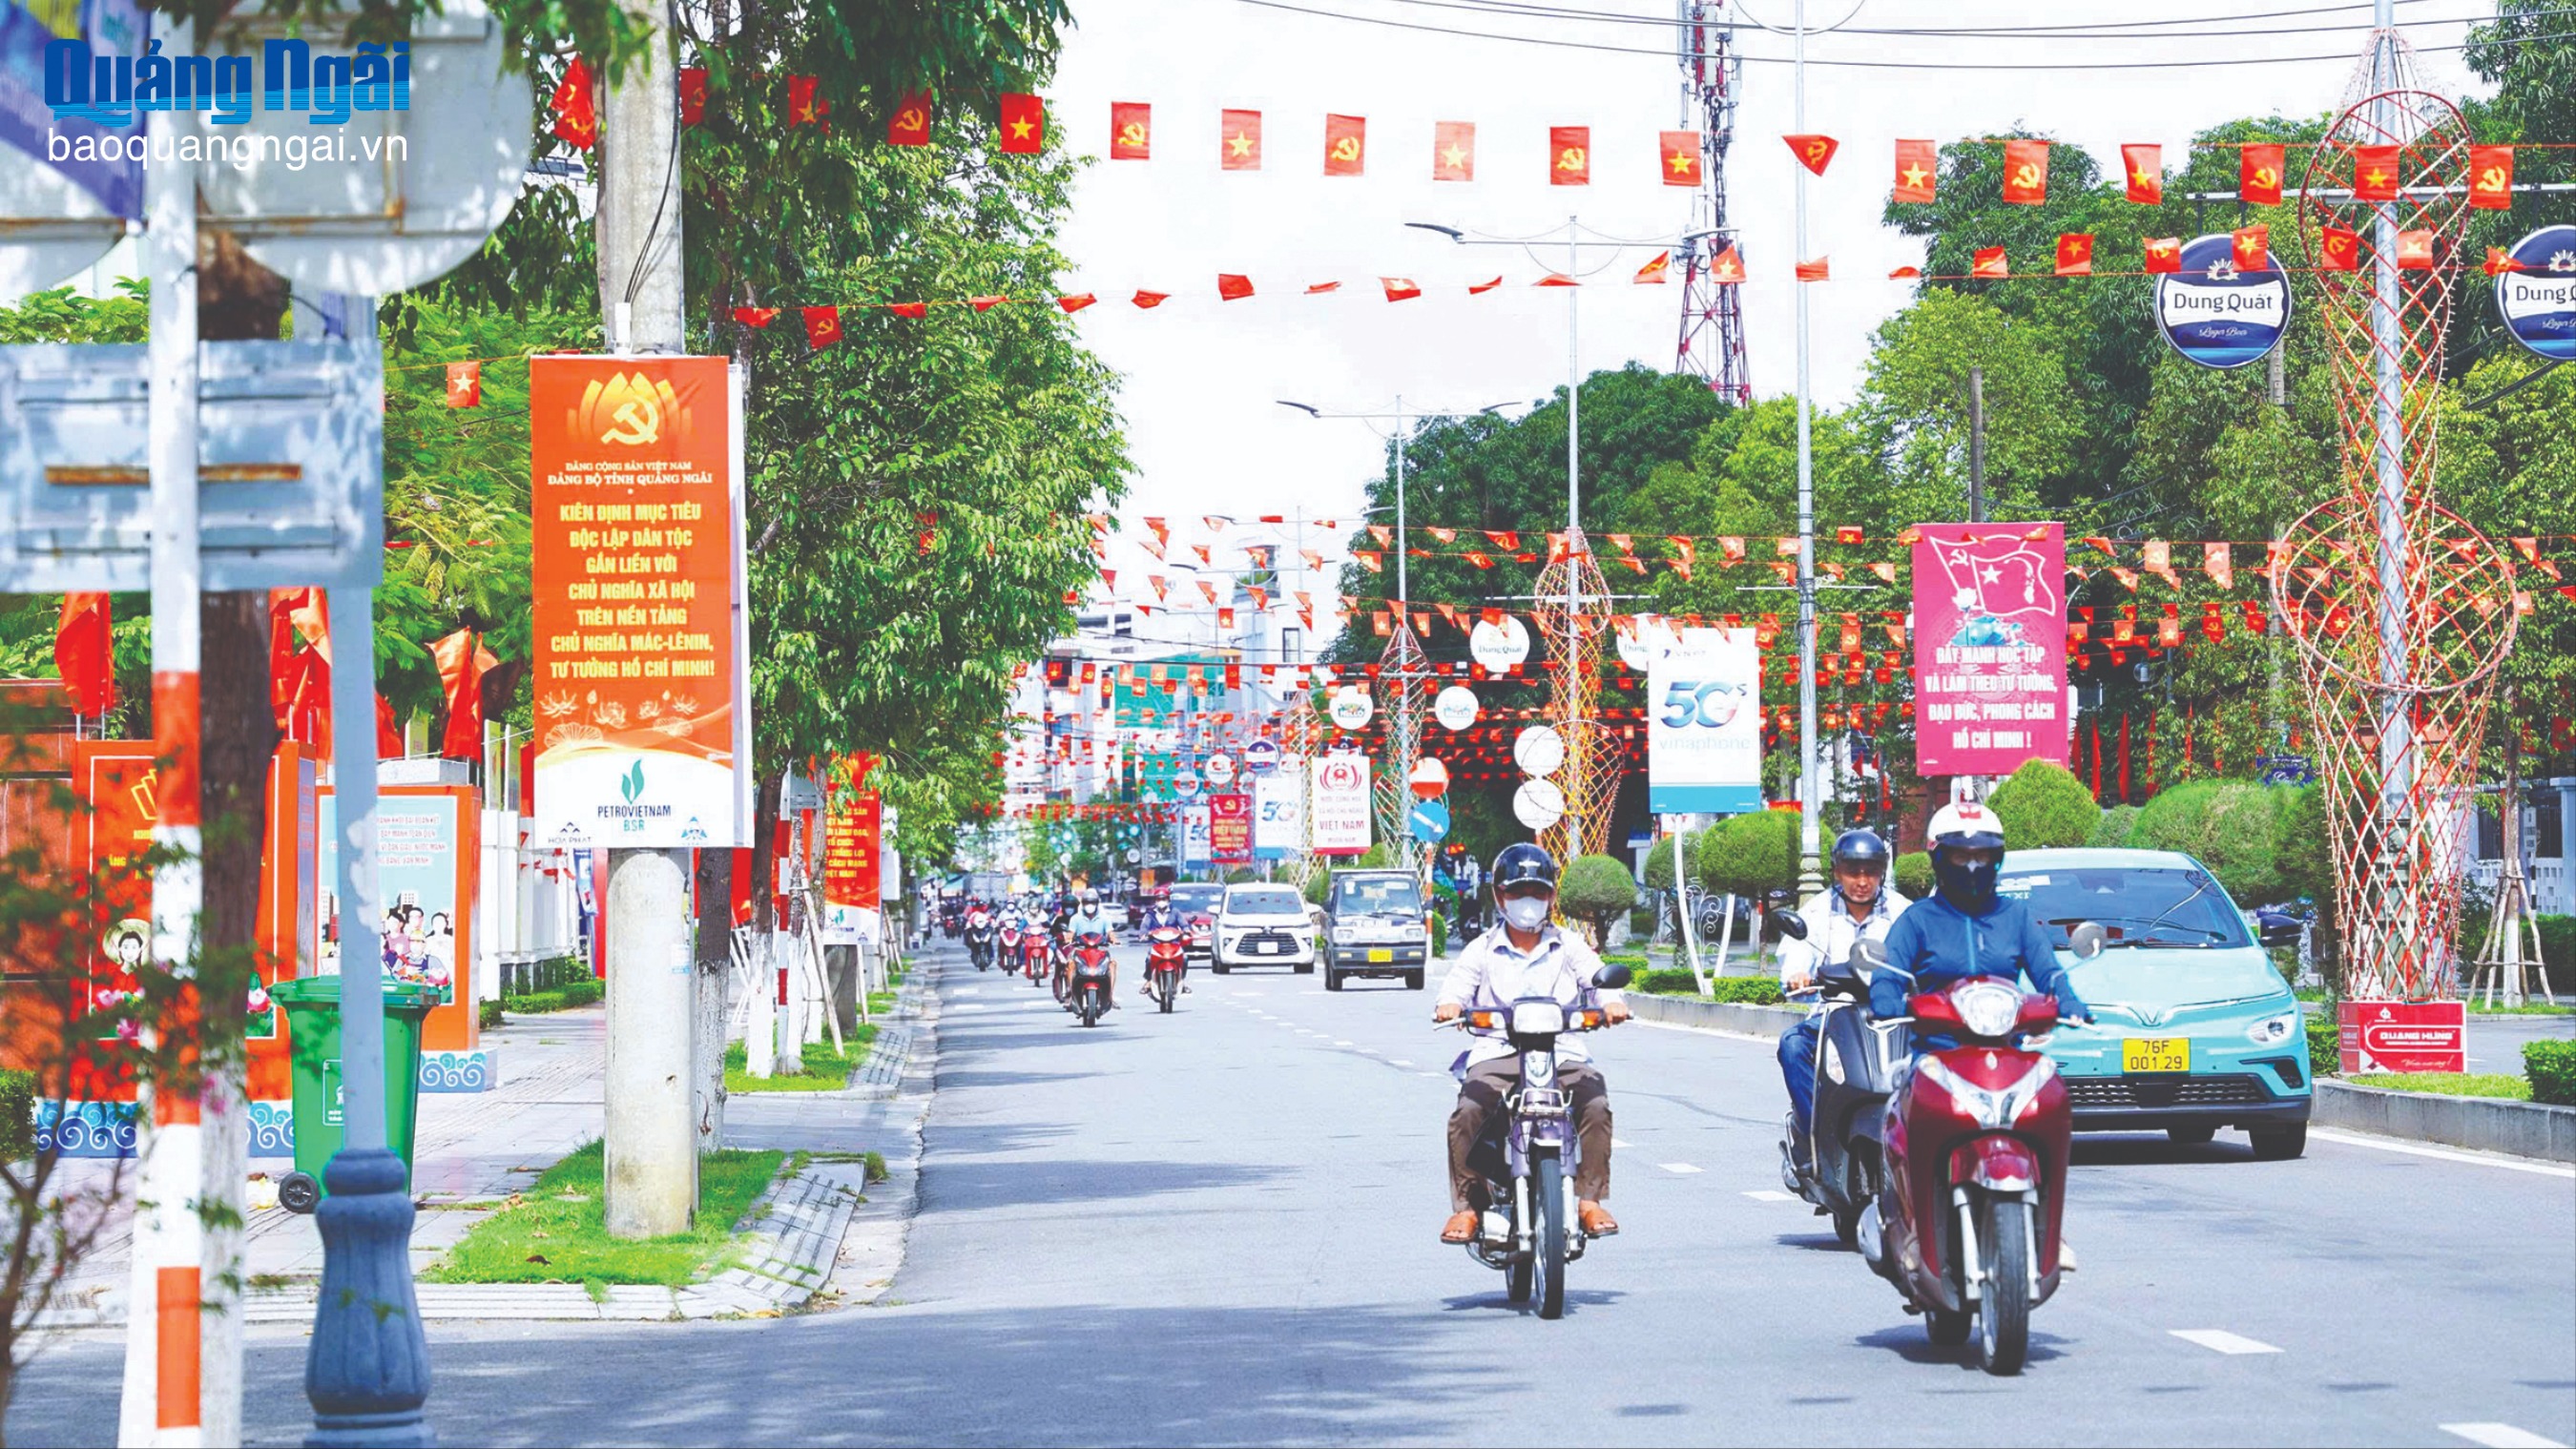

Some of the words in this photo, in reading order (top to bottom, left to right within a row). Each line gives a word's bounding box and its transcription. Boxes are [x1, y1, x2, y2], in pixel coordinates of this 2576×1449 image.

[2173, 293, 2224, 313] Dung
[2516, 285, 2566, 304] Dung
[670, 462, 692, 470] NAM
[548, 472, 582, 485] ĐẢNG
[585, 472, 601, 486] BỘ
[606, 471, 634, 485] TỈNH
[637, 471, 679, 485] QUẢNG
[560, 503, 593, 521] KIÊN
[597, 504, 632, 525] ĐỊNH
[635, 504, 667, 524] MỤC
[671, 501, 701, 520] TIÊU
[570, 528, 598, 550] ĐỘC
[603, 528, 629, 550] LẬP
[633, 528, 662, 547] DÂN
[665, 527, 693, 549] TỘC
[586, 551, 616, 573] GẮN
[619, 552, 651, 572] LIỀN
[654, 553, 677, 572] VỚI
[569, 580, 596, 600] CHỦ
[601, 581, 644, 599] NGHĨA
[648, 579, 668, 598] XÃ
[671, 580, 695, 602] HỘI
[577, 607, 613, 626] TRÊN
[616, 605, 646, 626] NỀN
[650, 605, 687, 625] TẢNG
[551, 631, 578, 652] CHỦ
[584, 633, 627, 652] NGHĨA
[551, 660, 570, 678] TƯ
[571, 657, 617, 678] TƯỞNG
[622, 658, 640, 677] HỒ
[645, 658, 668, 676] CHÍ
[672, 660, 715, 676] MINH!
[1924, 672, 1941, 693] VÀ
[1942, 672, 1967, 693] LÀM
[1968, 674, 1998, 693] THEO
[1928, 703, 1952, 724] ĐẠO
[1983, 703, 2022, 720] PHONG
[2024, 699, 2055, 720] CÁCH
[1658, 735, 1751, 753] vinaphone
[1953, 726, 1969, 749] HỒ
[1971, 728, 1991, 749] CHÍ
[1993, 731, 2024, 749] MINH
[2025, 731, 2031, 749] !
[597, 804, 672, 818] PETROVIETNAM
[623, 819, 645, 832] BSR
[2141, 1041, 2170, 1054] 76F
[2129, 1056, 2182, 1070] 001.29
